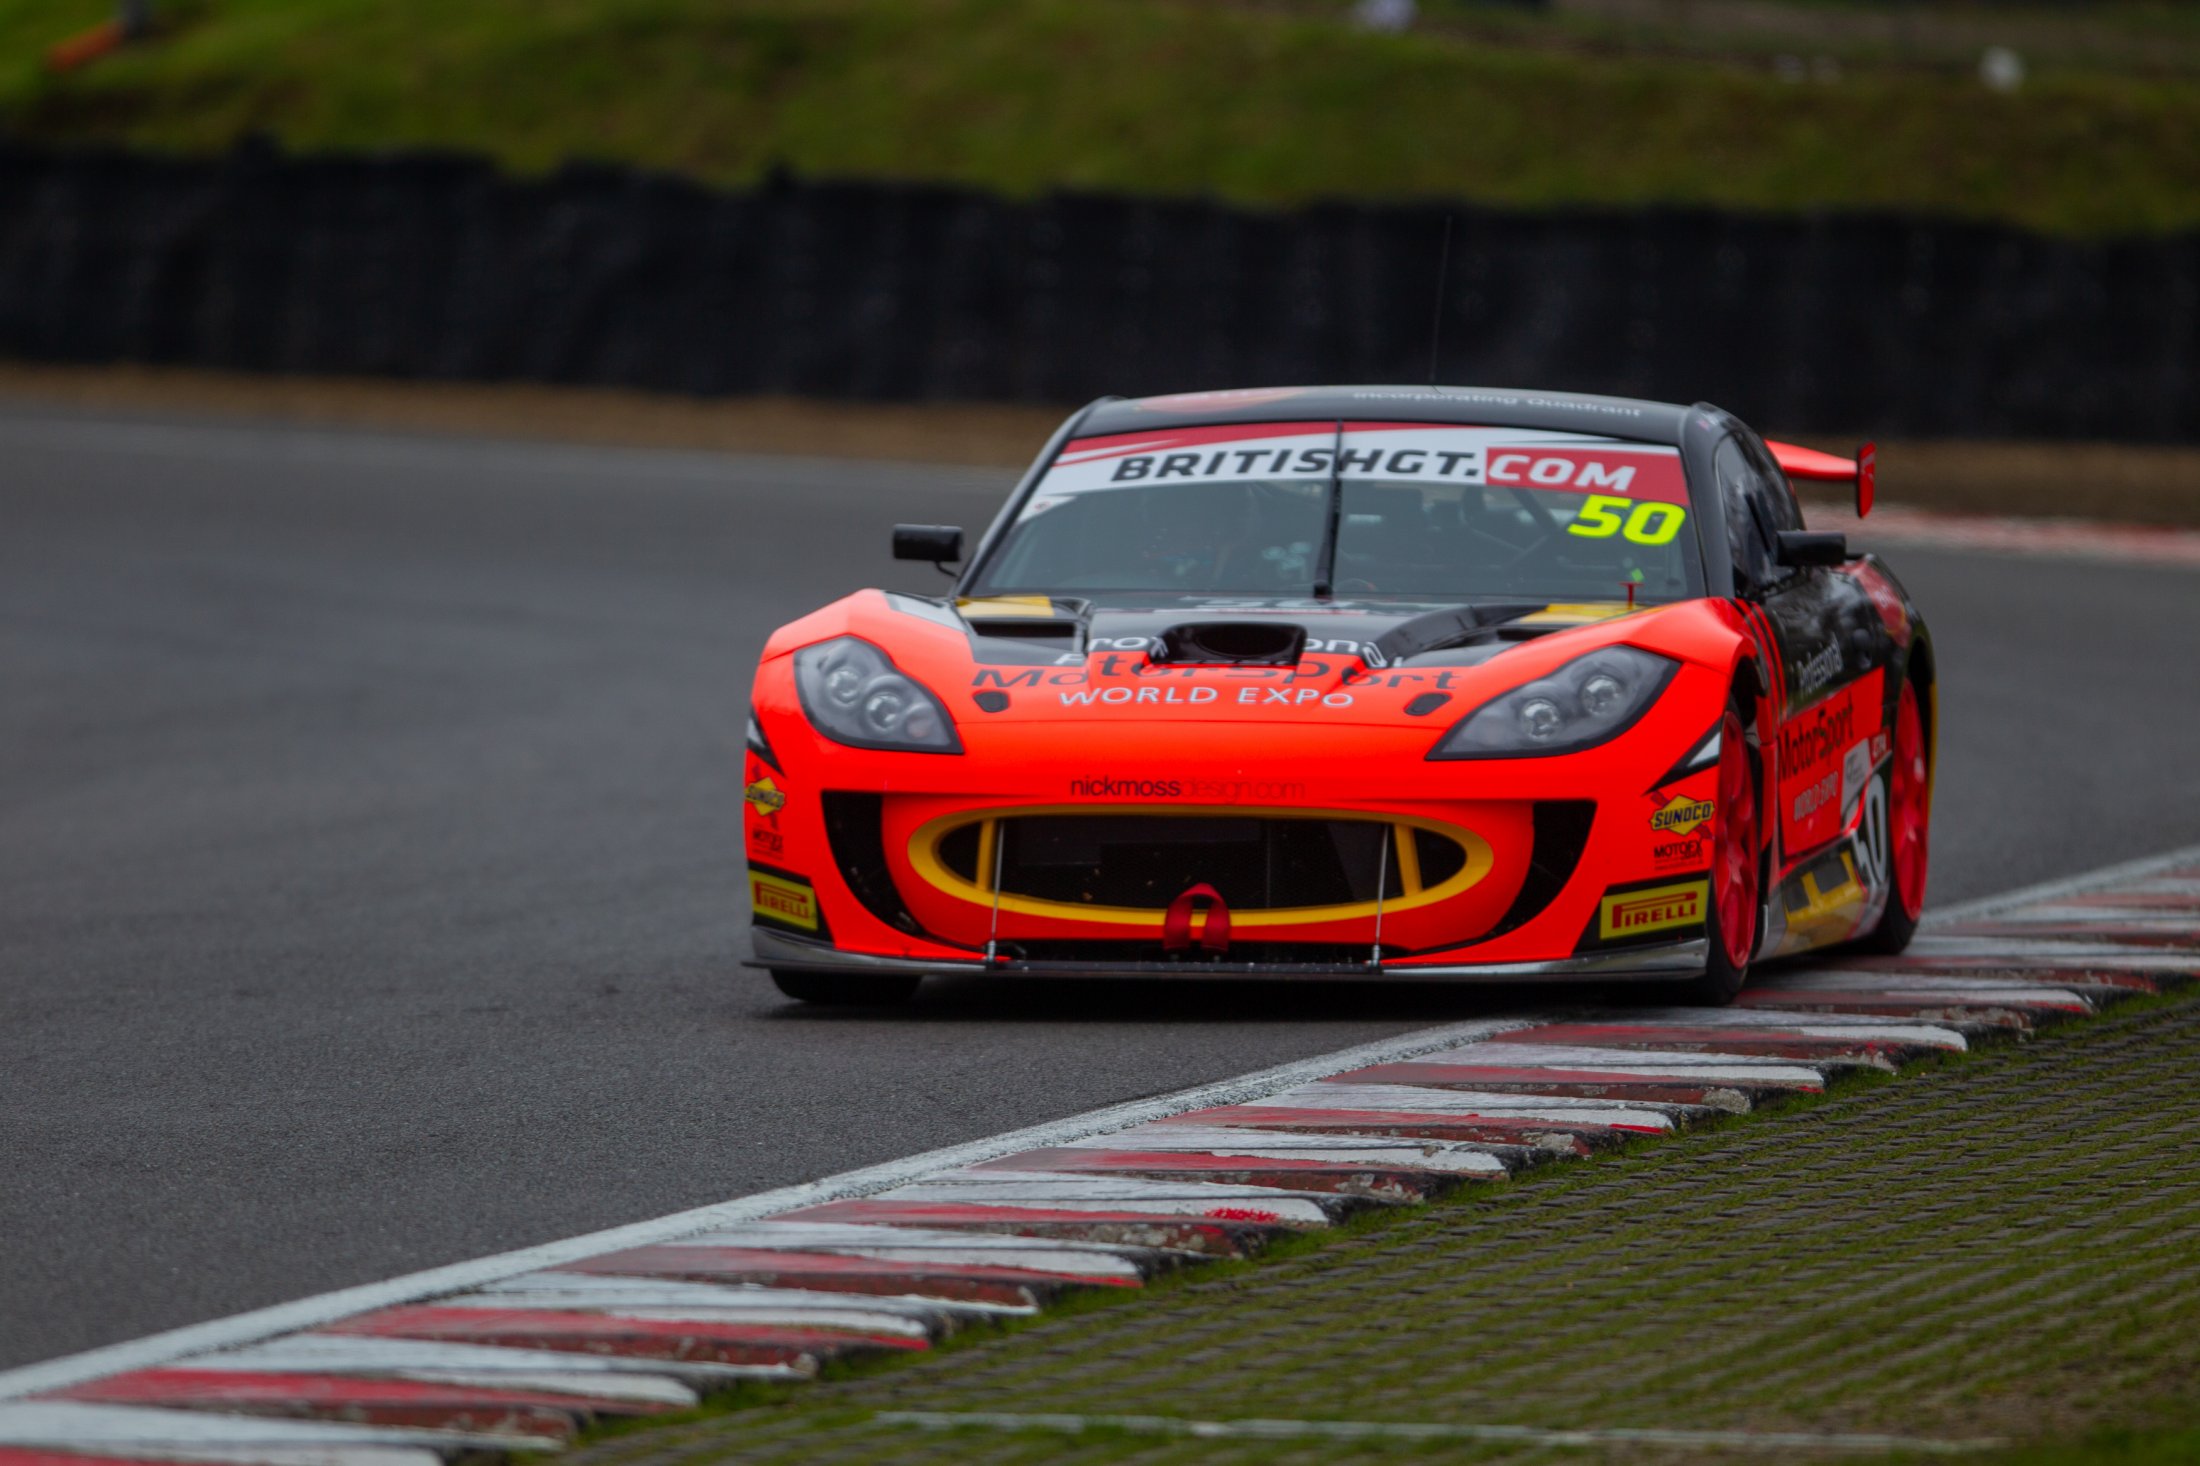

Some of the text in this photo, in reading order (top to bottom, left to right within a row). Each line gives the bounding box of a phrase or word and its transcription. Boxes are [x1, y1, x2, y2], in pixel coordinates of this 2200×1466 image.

[1110, 448, 1635, 491] BRITISHGT.COM
[1567, 494, 1686, 546] 50
[1058, 686, 1354, 708] WORLD EXPO
[1070, 775, 1305, 804] nickmossdesign.com
[1654, 803, 1711, 828] SUNOCO
[754, 881, 809, 918] PIRELLI
[1611, 891, 1698, 929] PIRELLI
